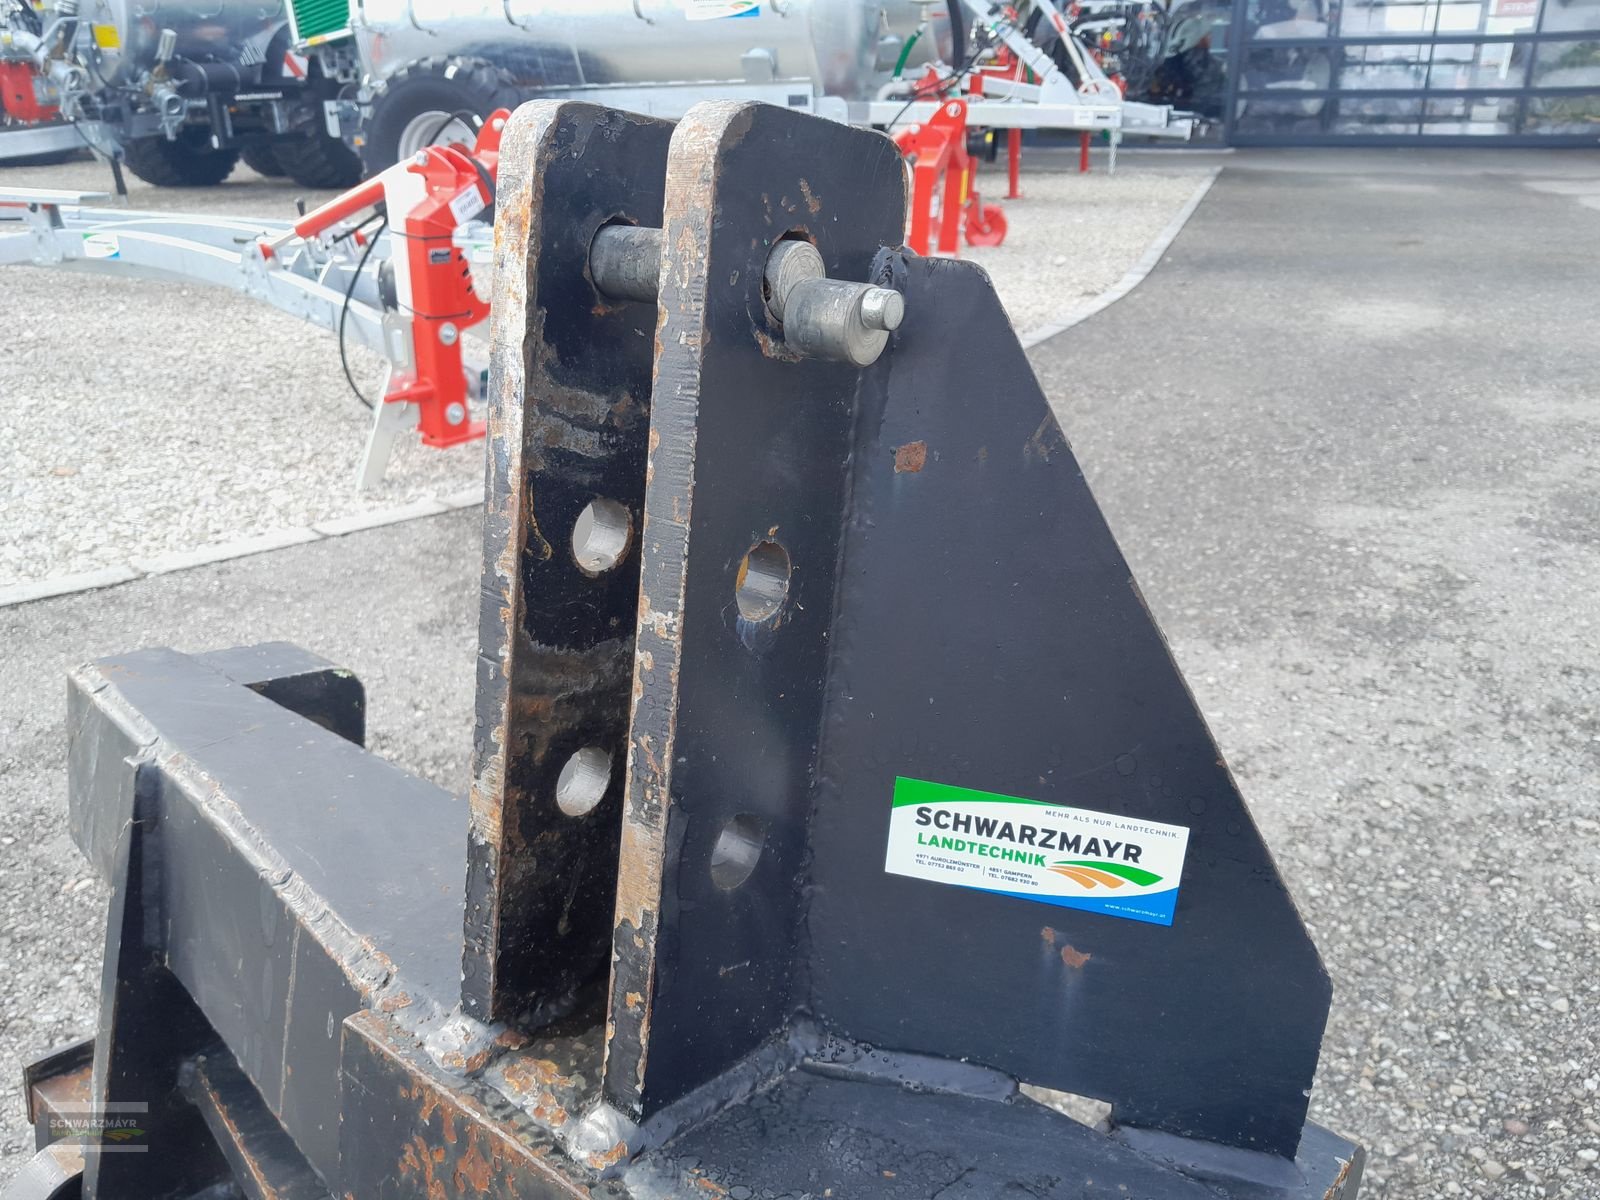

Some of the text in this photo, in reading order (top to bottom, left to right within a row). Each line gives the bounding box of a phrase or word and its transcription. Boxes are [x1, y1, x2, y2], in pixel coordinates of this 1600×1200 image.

[915, 806, 1142, 864] SCHWARZMAYR
[1045, 810, 1180, 839] MEHR ALS NUR LANDTECHNIK.
[916, 832, 1046, 868] LANDTECHNIK
[1004, 869, 1033, 879] GAMPERN
